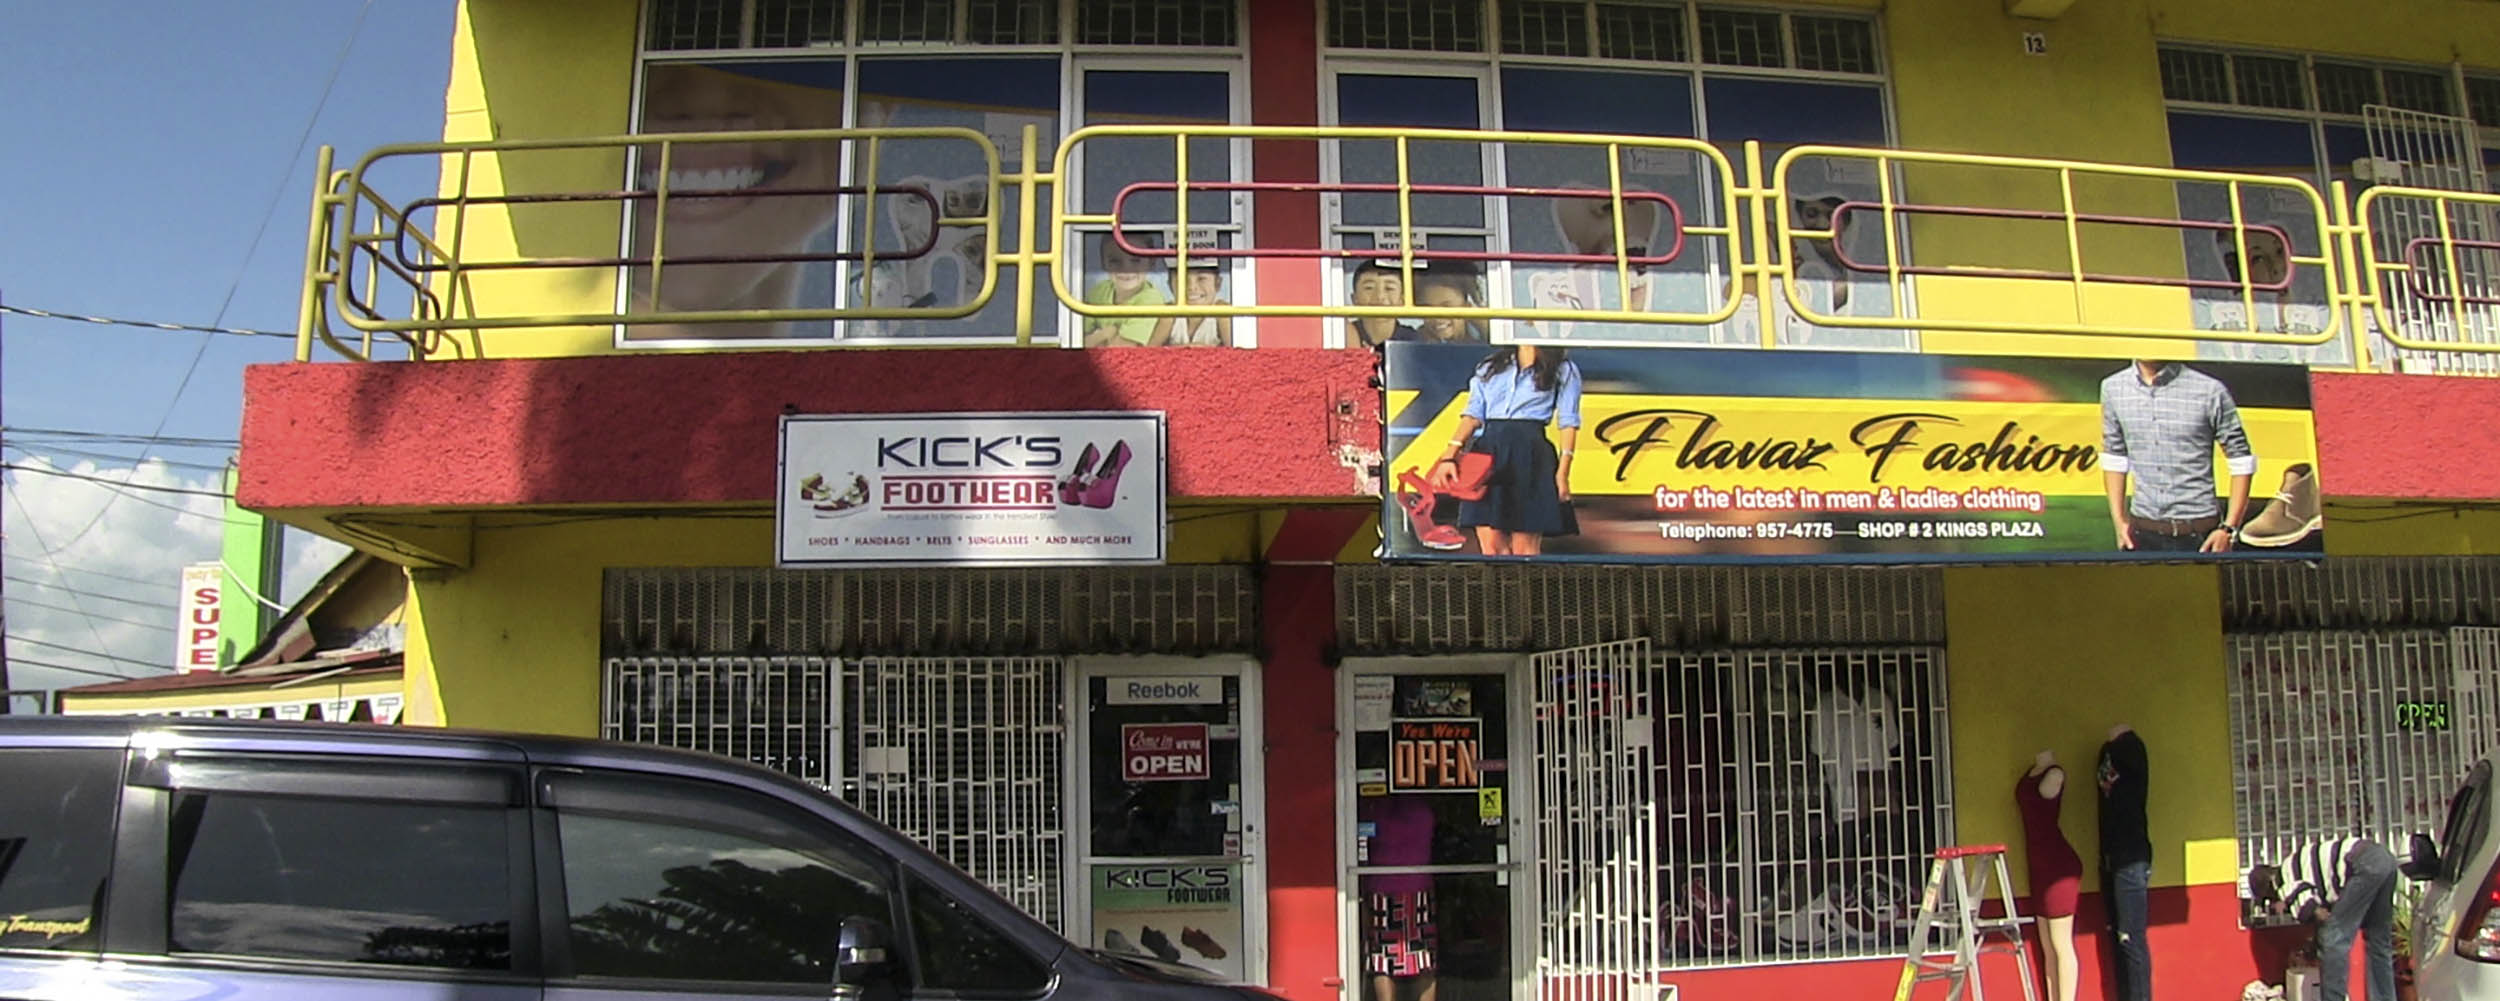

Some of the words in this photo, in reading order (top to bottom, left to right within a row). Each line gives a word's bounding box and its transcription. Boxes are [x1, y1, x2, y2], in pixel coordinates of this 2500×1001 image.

[878, 436, 1062, 468] KICK'S
[1594, 409, 1833, 482] Flavaz
[1849, 412, 2099, 483] Fashion
[883, 481, 1054, 504] FOOTWEAR
[1656, 487, 1688, 508] for
[1694, 486, 1729, 508] the
[1735, 487, 1794, 509] latest
[1801, 487, 1818, 508] in
[1827, 490, 1871, 509] men
[1878, 488, 1896, 508] &
[1901, 487, 1958, 509] ladies
[1963, 488, 2042, 511] clothing
[808, 536, 839, 546] SHOES
[854, 536, 910, 545] HANDBAGS
[926, 536, 952, 545] BELTS
[968, 536, 1029, 545] SUNGLASSES
[1045, 536, 1067, 545] AND
[1070, 536, 1100, 545] MUCH
[1104, 536, 1132, 545] MORE
[1659, 523, 1753, 541] Telephone:
[1757, 523, 1833, 538] 957-4775
[1858, 522, 1905, 537] SHOP
[1922, 523, 1932, 537] 2
[1936, 522, 1988, 537] KINGS
[1991, 522, 2044, 537] PLAZA
[191, 587, 220, 673] SUPE
[1128, 682, 1201, 698] Reebok
[1130, 755, 1203, 774] OPEN
[1395, 740, 1477, 787] OPEN
[1167, 888, 1231, 903] FOOTWEAR
[8, 914, 91, 940] Transport
